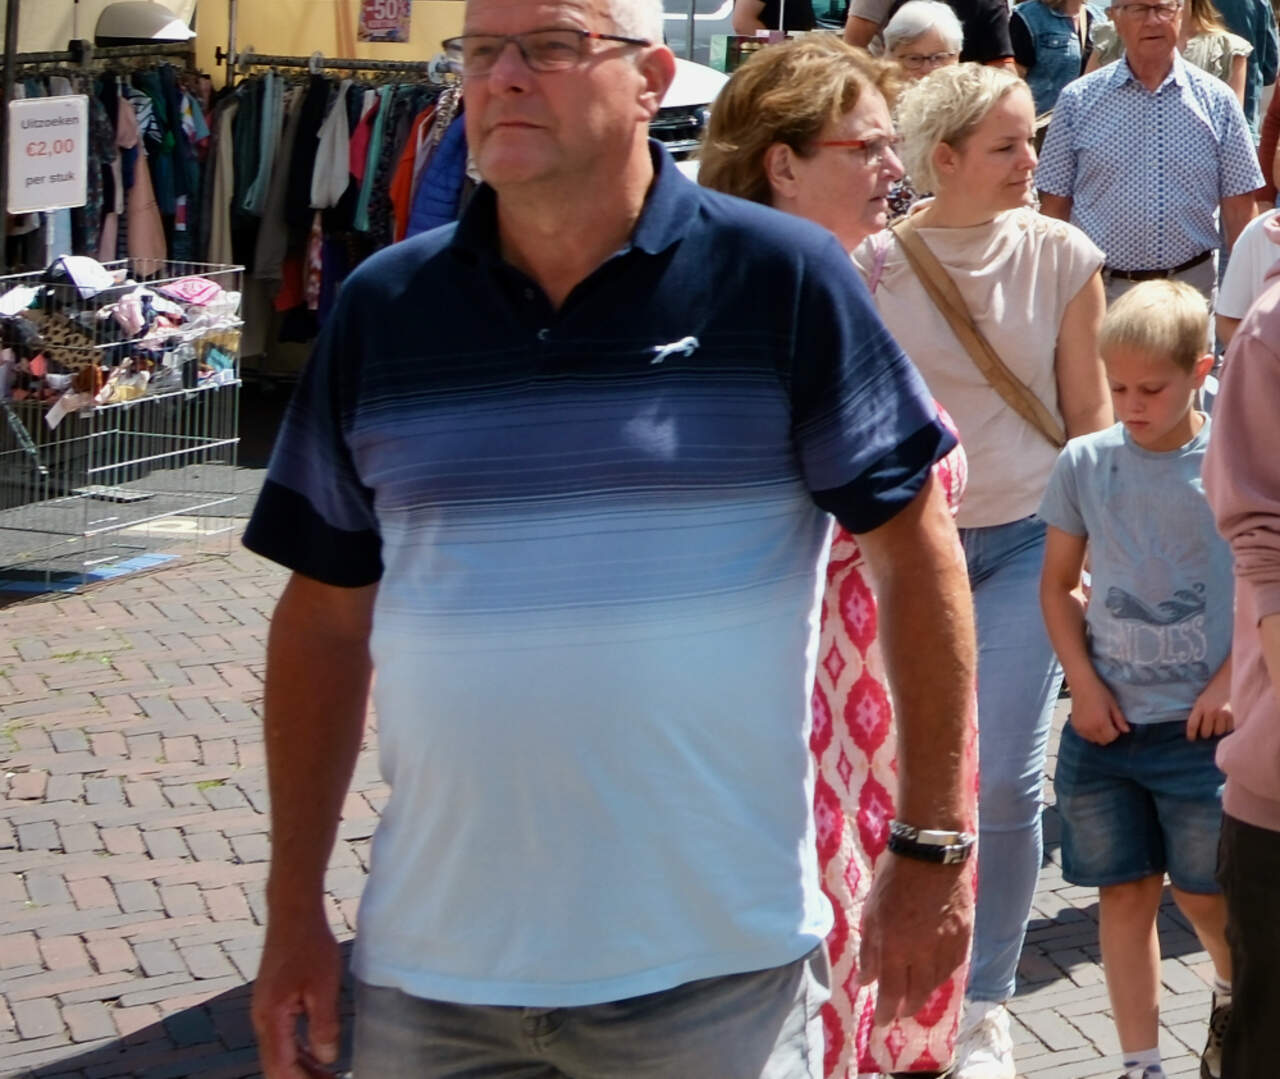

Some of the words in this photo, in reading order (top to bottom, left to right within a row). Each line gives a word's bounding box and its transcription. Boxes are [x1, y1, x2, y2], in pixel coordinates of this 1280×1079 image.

[25, 138, 75, 157] €2,00
[25, 175, 46, 188] per
[48, 171, 75, 184] stuk
